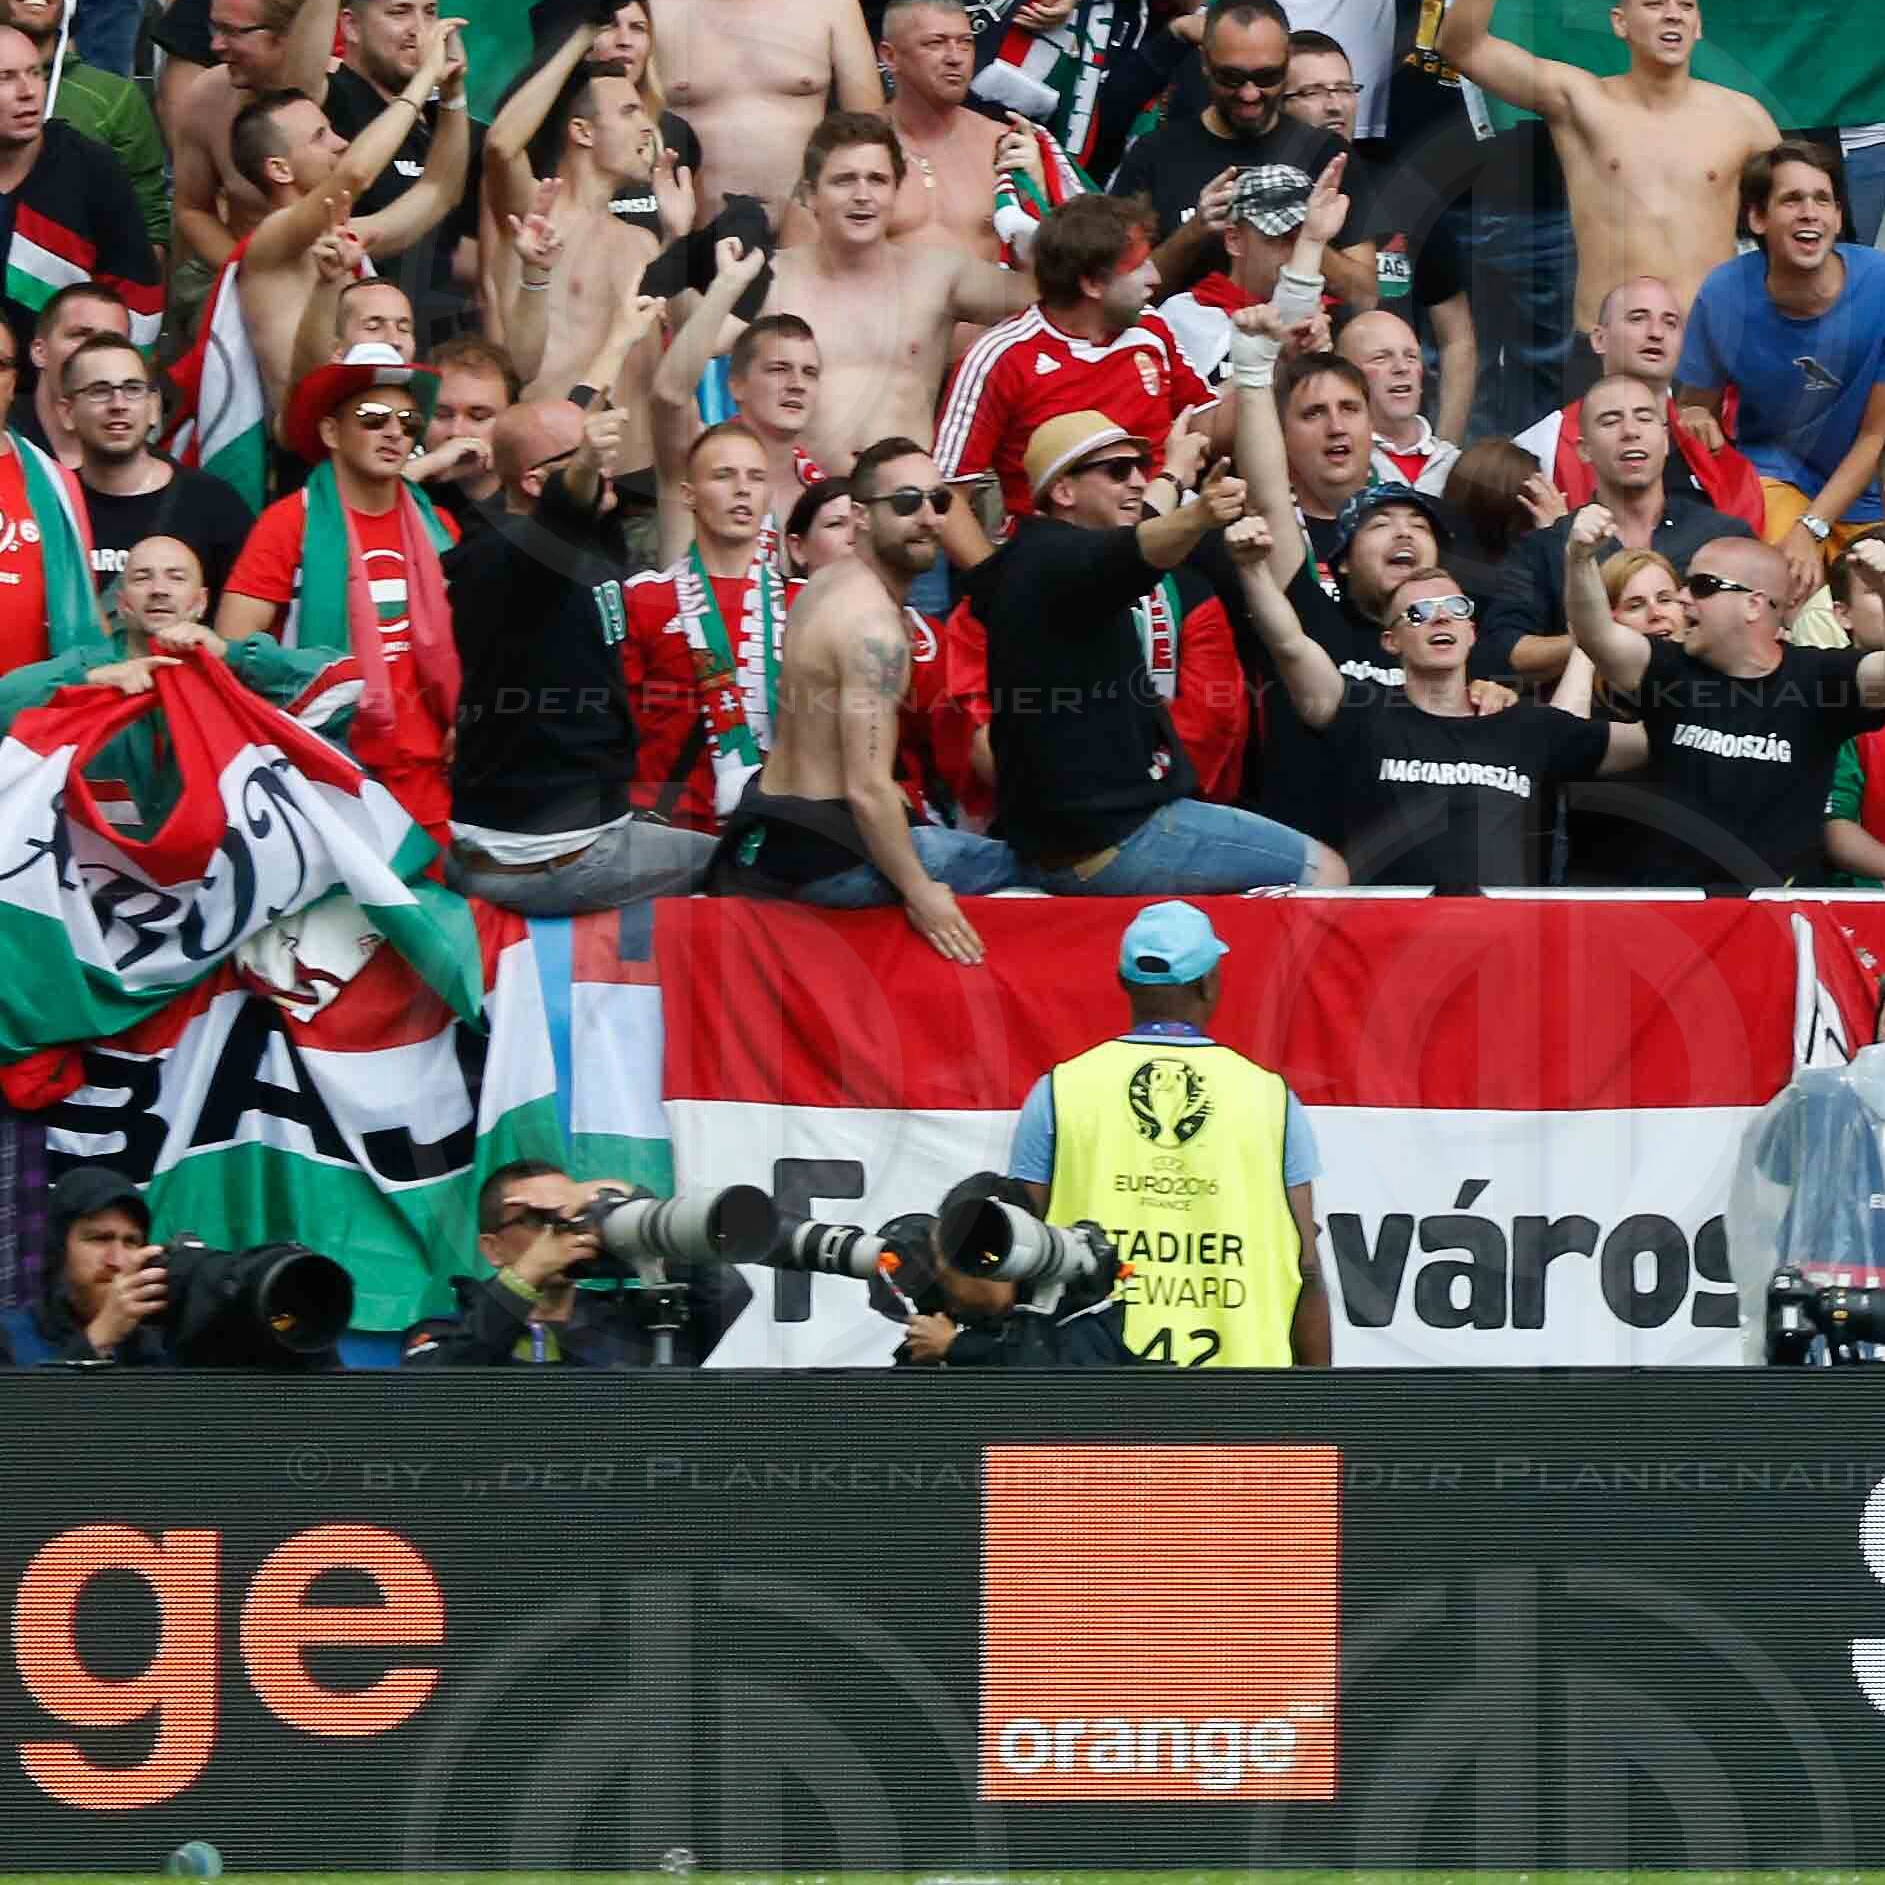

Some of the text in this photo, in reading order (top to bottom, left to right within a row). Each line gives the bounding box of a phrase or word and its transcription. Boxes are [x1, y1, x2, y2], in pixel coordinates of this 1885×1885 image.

[1106, 1232, 1245, 1266] TADIER
[12, 1523, 446, 1811] ge
[997, 1707, 1304, 1789] orange
